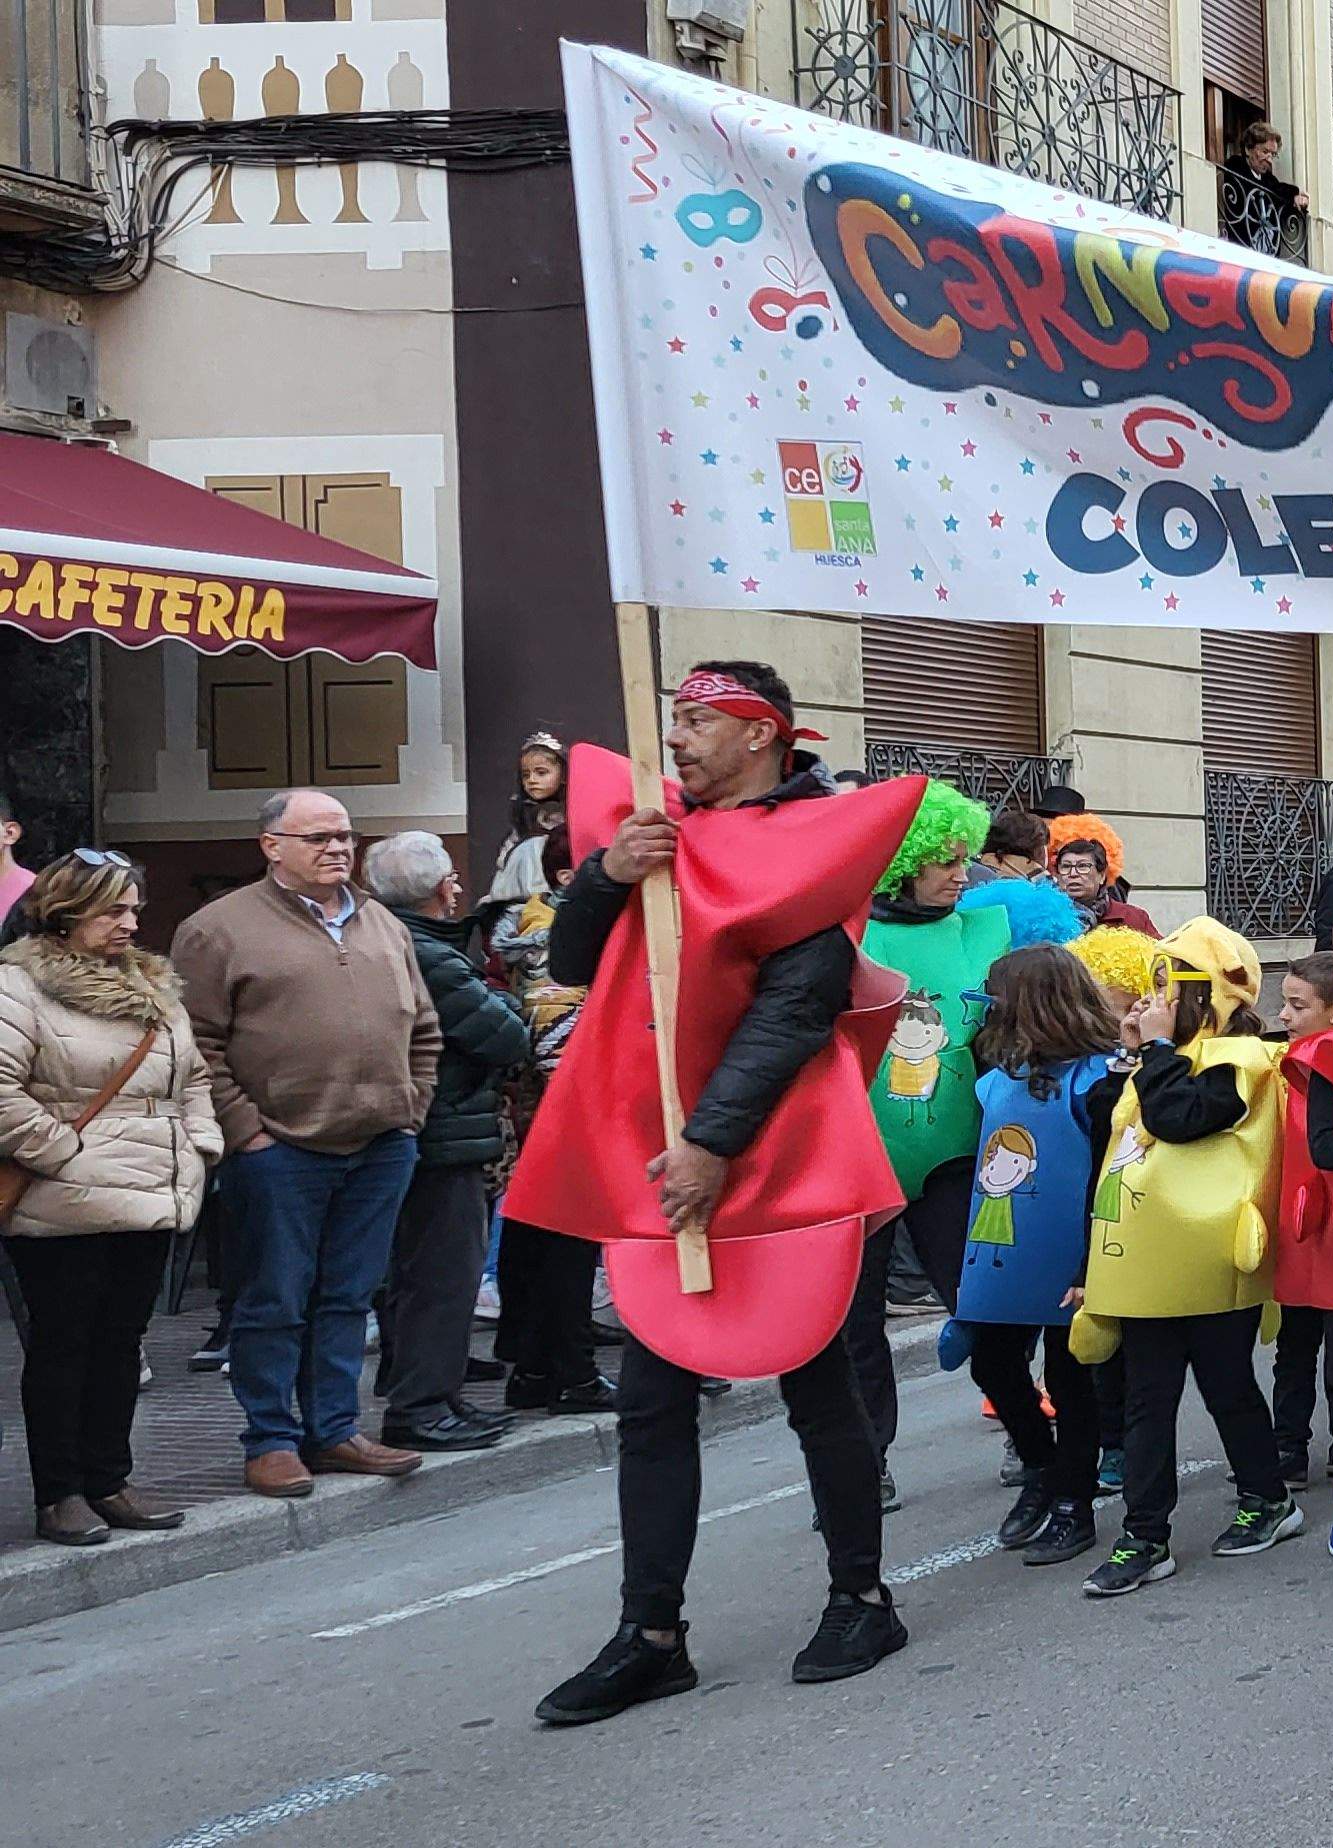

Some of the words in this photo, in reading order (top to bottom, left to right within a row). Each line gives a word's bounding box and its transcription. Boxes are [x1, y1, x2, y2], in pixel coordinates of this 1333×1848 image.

[784, 467, 821, 493] ce
[837, 536, 875, 554] ANA
[815, 554, 862, 567] HUESCA
[0, 553, 285, 641] CAFETERIA
